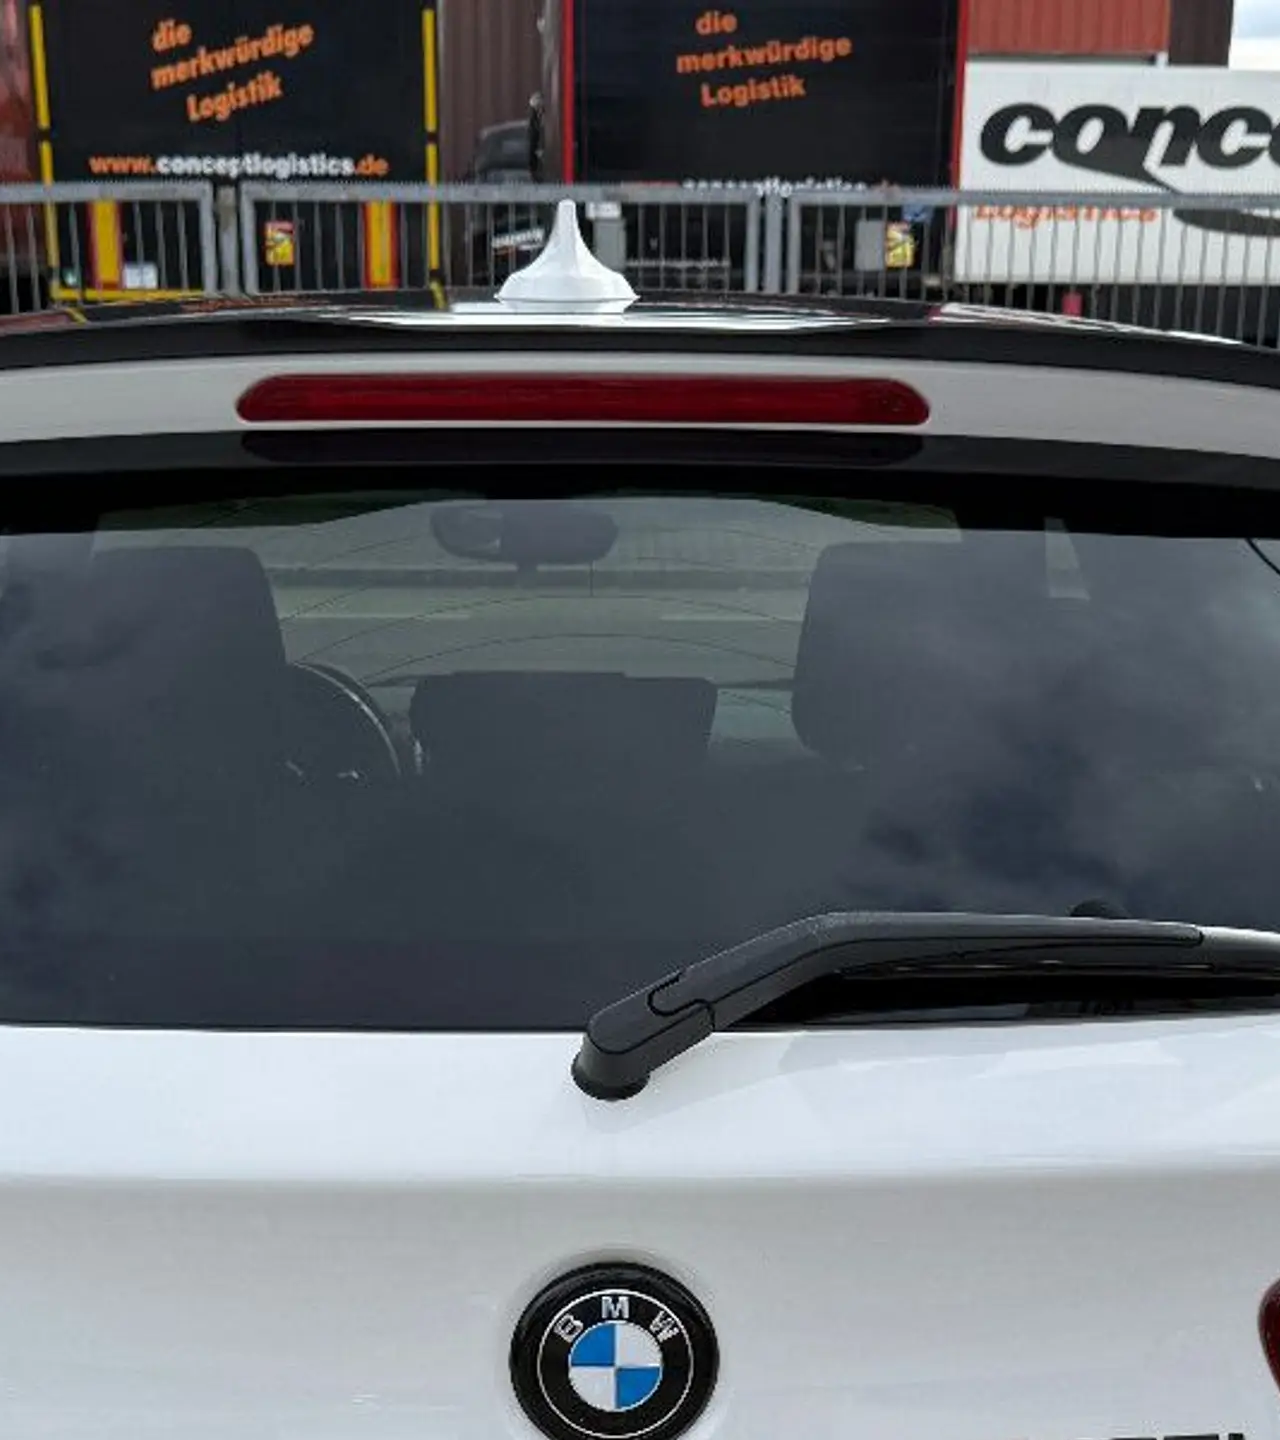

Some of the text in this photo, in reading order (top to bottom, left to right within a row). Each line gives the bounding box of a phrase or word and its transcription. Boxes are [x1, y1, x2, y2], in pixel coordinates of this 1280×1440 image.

[152, 19, 192, 50] die
[695, 11, 738, 35] die
[150, 23, 315, 88] merkwürdige
[676, 36, 853, 73] merkwürdige
[186, 69, 283, 122] Logistik
[700, 74, 805, 107] Logistik
[89, 152, 390, 178] www.conceptlogistics.de
[553, 1296, 680, 1344] BMW
